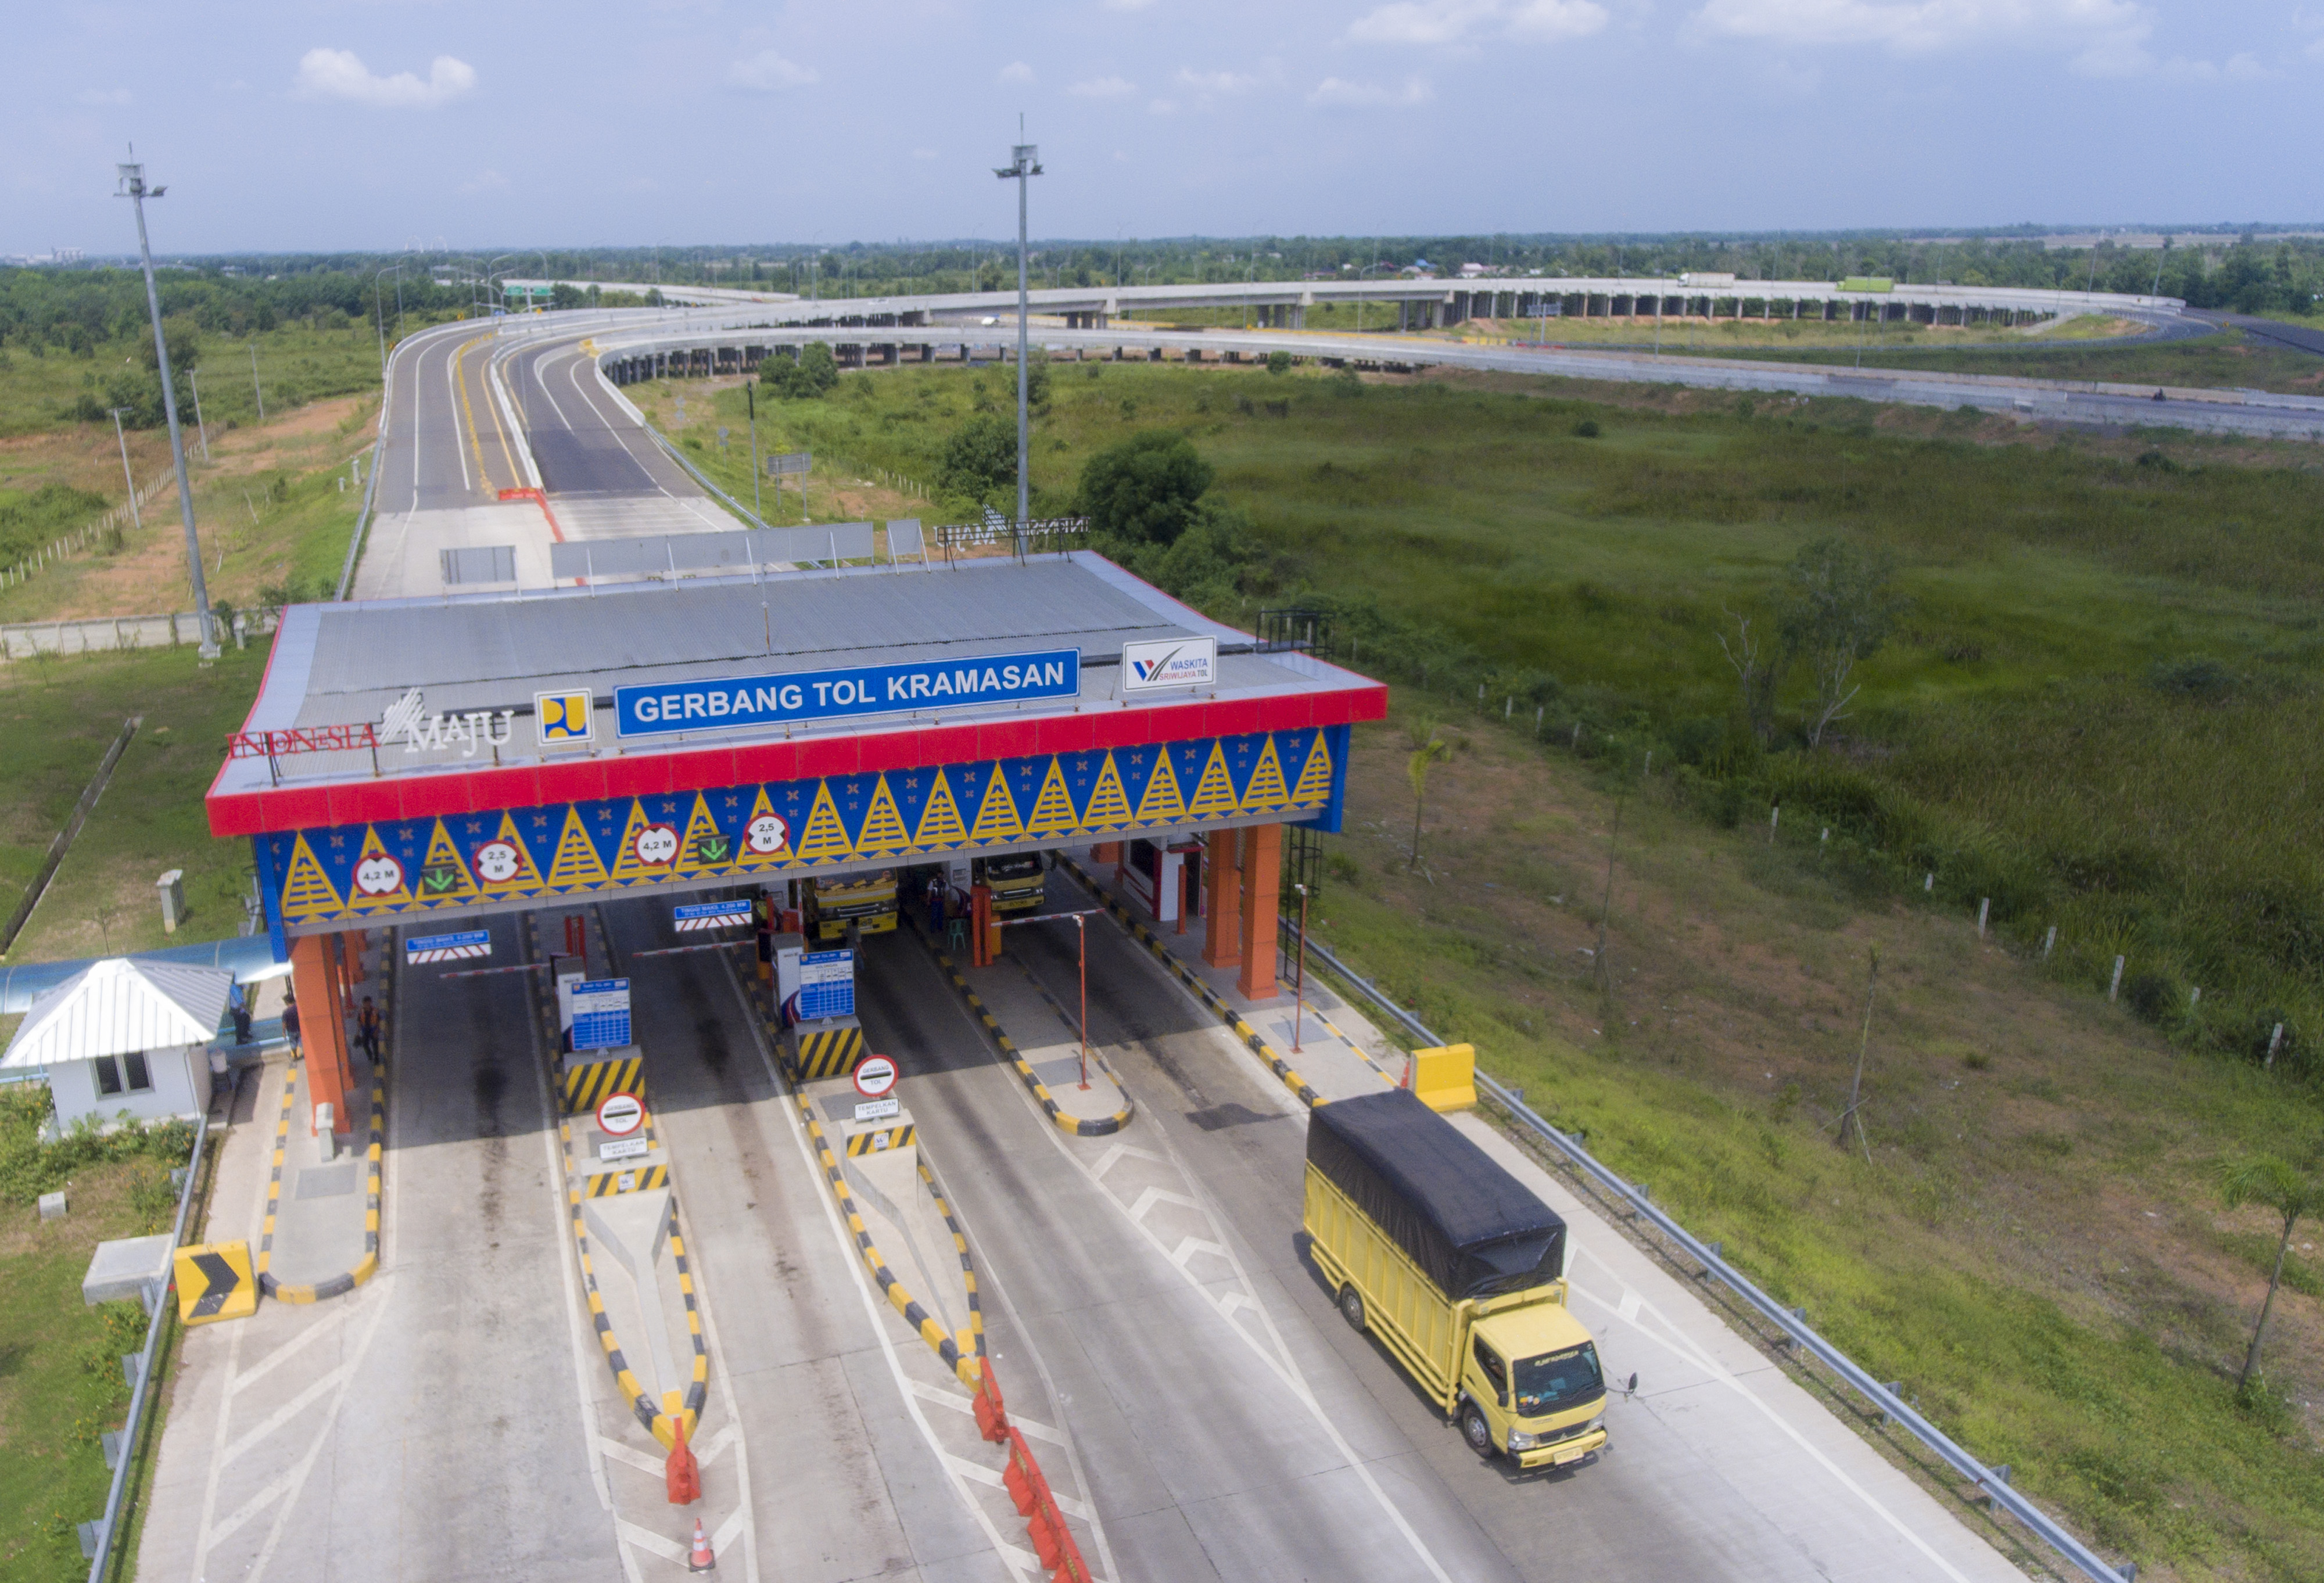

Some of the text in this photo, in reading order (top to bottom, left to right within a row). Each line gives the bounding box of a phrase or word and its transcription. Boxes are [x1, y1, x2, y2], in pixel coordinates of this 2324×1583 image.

[1170, 658, 1208, 671] WASKITA
[1159, 669, 1208, 681] SRIWIJAYA TOL
[634, 662, 1064, 722] GERBANG TOL KRAMASAN
[225, 710, 514, 760] INDONESIA MAJU
[759, 823, 774, 832] 2,5
[643, 840, 672, 851] 4,2 M
[763, 837, 772, 845] M
[488, 850, 506, 862] 2,5
[494, 864, 504, 873] M
[363, 870, 394, 881] 4,2 M
[863, 1065, 890, 1074] GERBANG
[858, 1101, 896, 1111] TEMPELKAN
